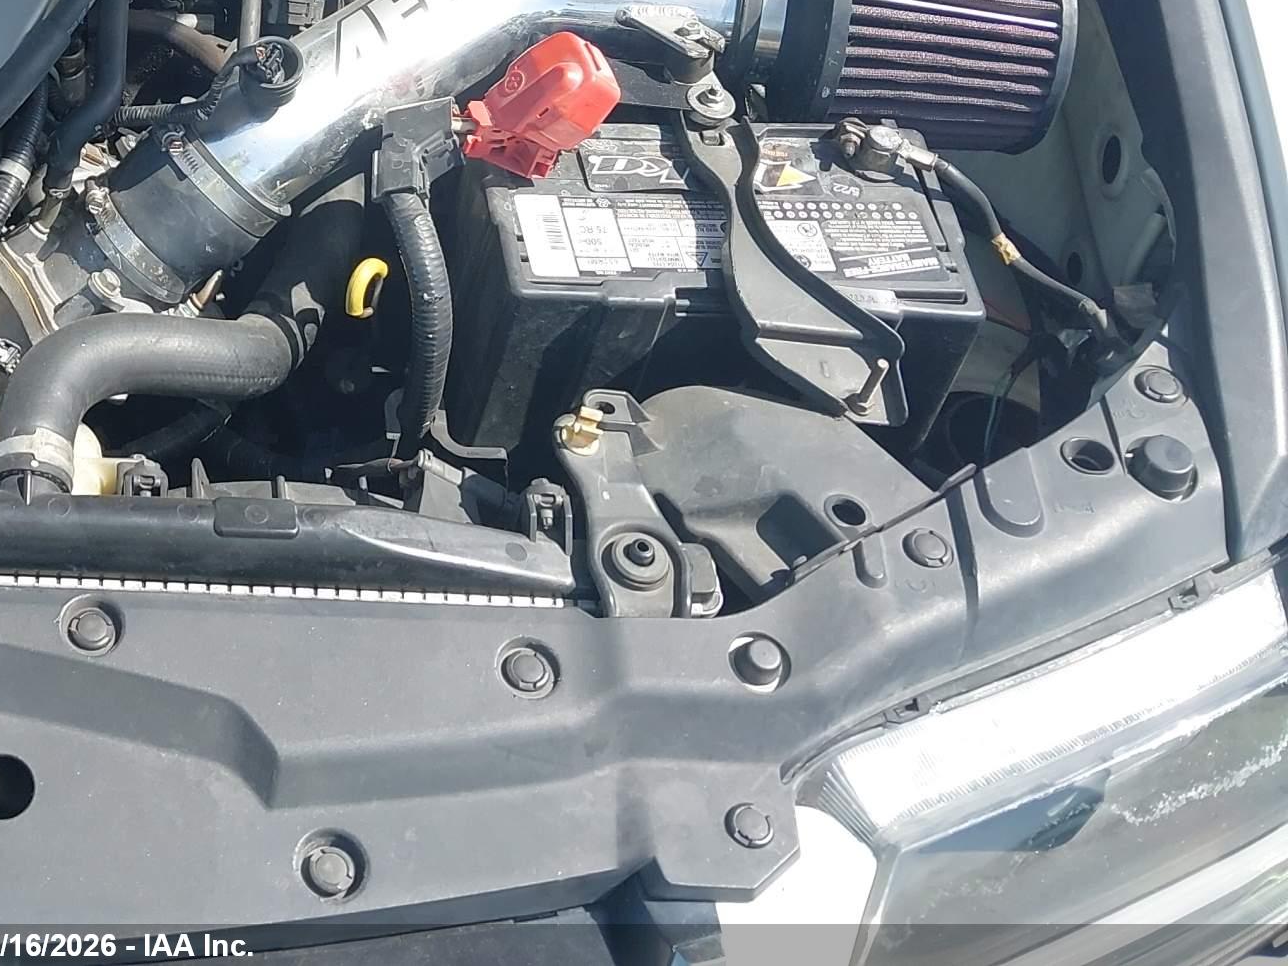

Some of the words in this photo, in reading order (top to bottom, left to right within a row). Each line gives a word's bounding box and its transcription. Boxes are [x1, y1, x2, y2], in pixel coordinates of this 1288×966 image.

[832, 183, 861, 198] 5/22
[868, 253, 911, 266] BATTERY
[843, 257, 940, 278] MAINTENANCE-FREE
